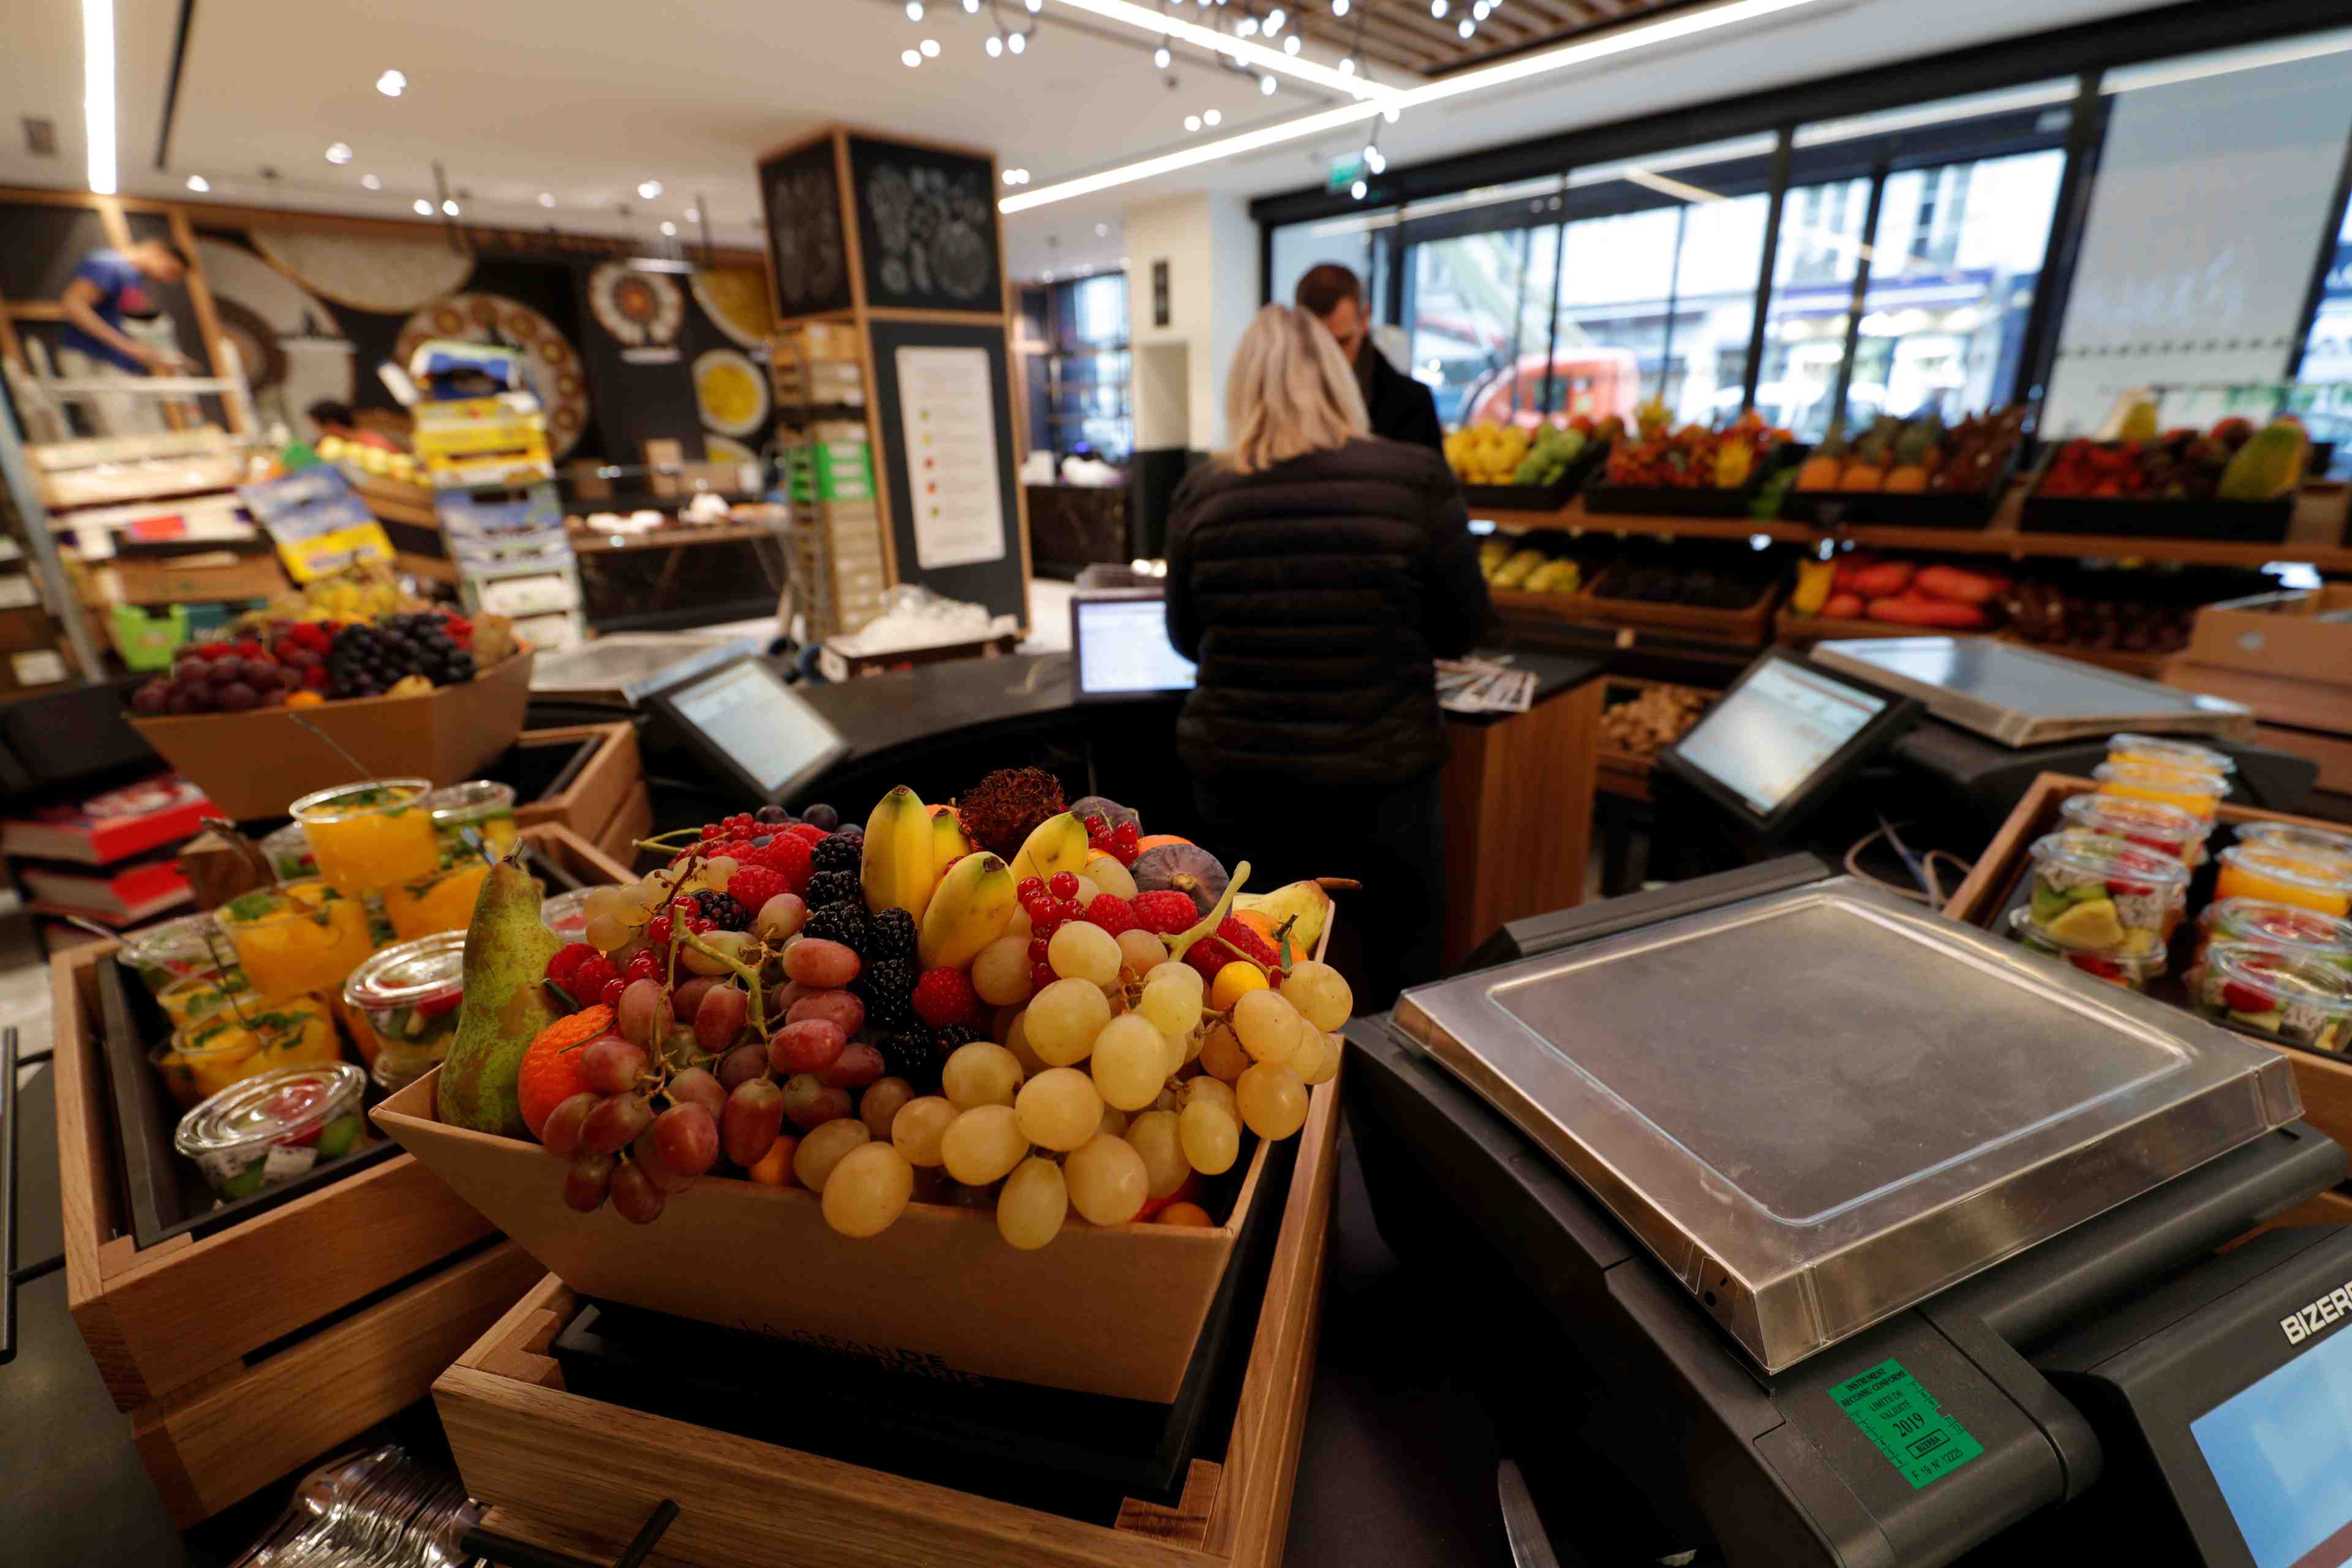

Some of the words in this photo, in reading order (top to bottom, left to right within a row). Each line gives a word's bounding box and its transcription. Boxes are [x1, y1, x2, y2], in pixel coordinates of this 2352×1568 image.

[1842, 1387, 1872, 1407] RECONNU
[1871, 1370, 1907, 1390] CONFORME
[1846, 1367, 1887, 1392] INSTRUMENT
[1869, 1395, 1893, 1412] LIMITE
[1891, 1390, 1904, 1400] DE
[1892, 1412, 1925, 1438] 2019
